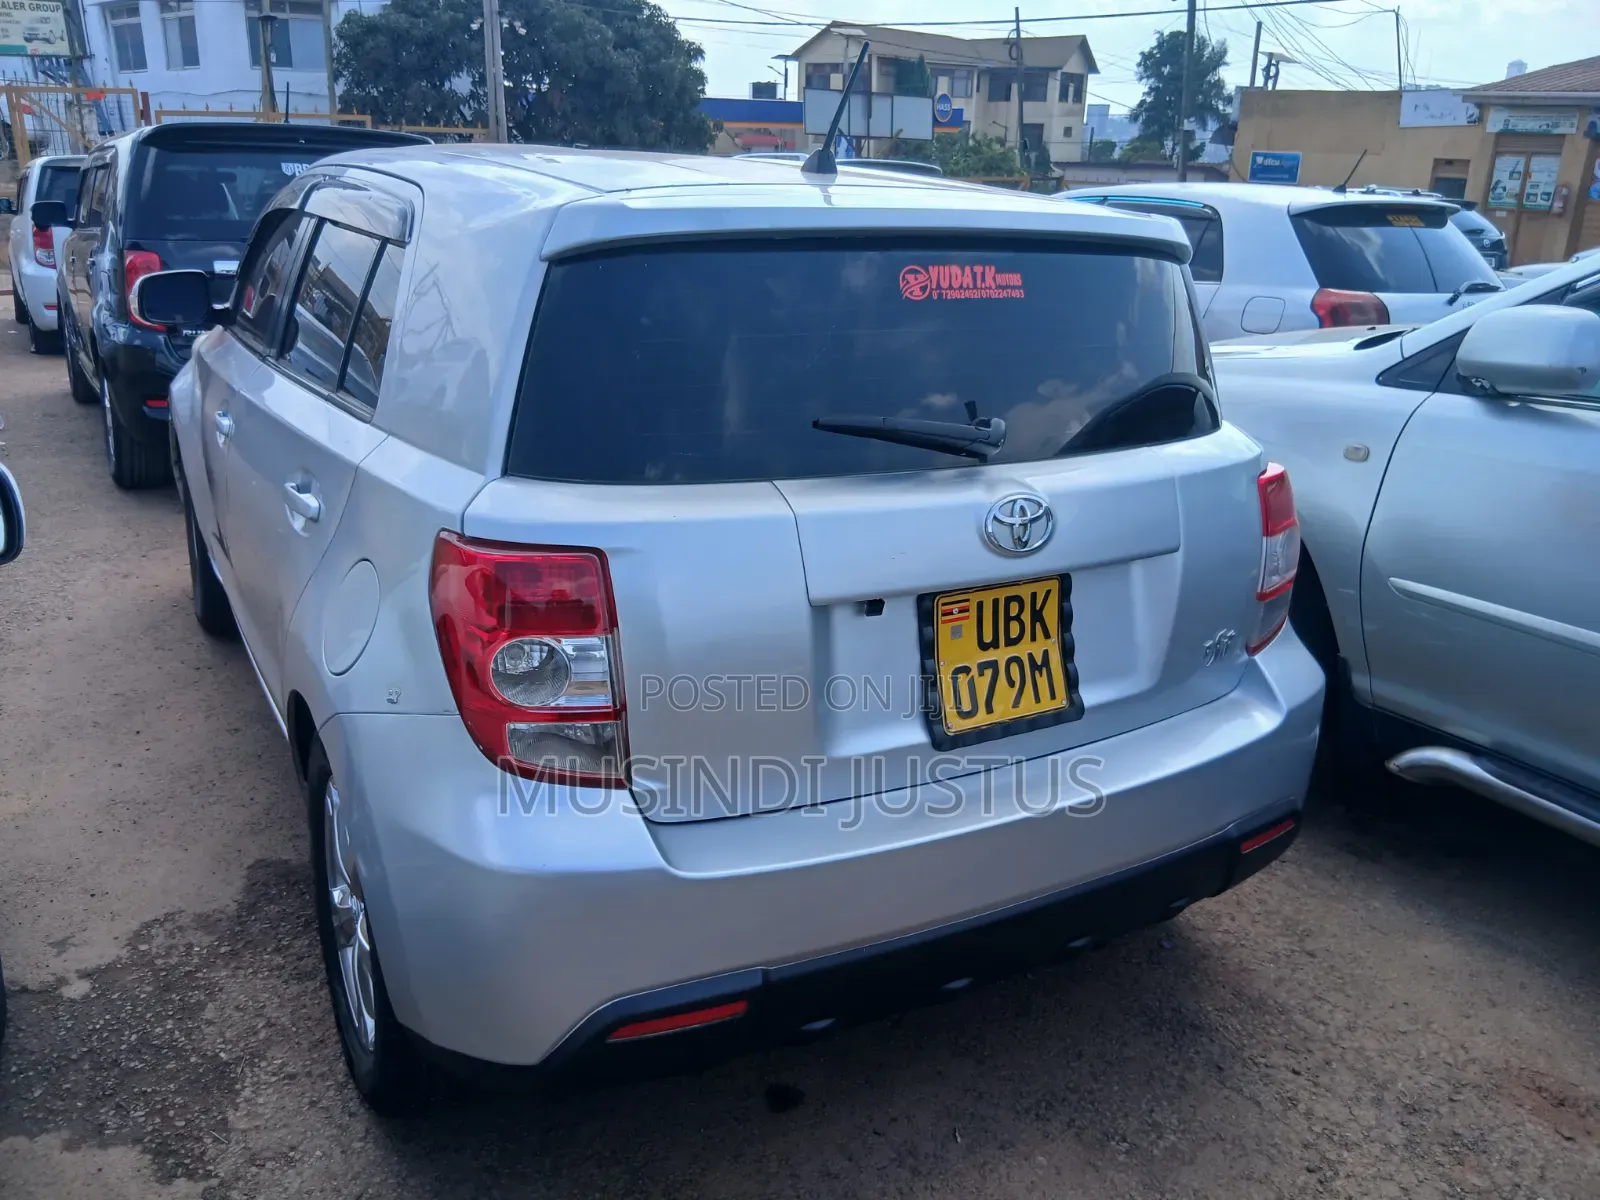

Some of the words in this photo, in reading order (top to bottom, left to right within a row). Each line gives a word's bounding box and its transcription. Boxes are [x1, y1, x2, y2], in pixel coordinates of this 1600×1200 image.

[0, 0, 26, 11] ALER
[28, 2, 61, 13] GROUP
[936, 103, 951, 111] HASS
[976, 589, 1052, 651] UBK
[952, 652, 1056, 719] 079M
